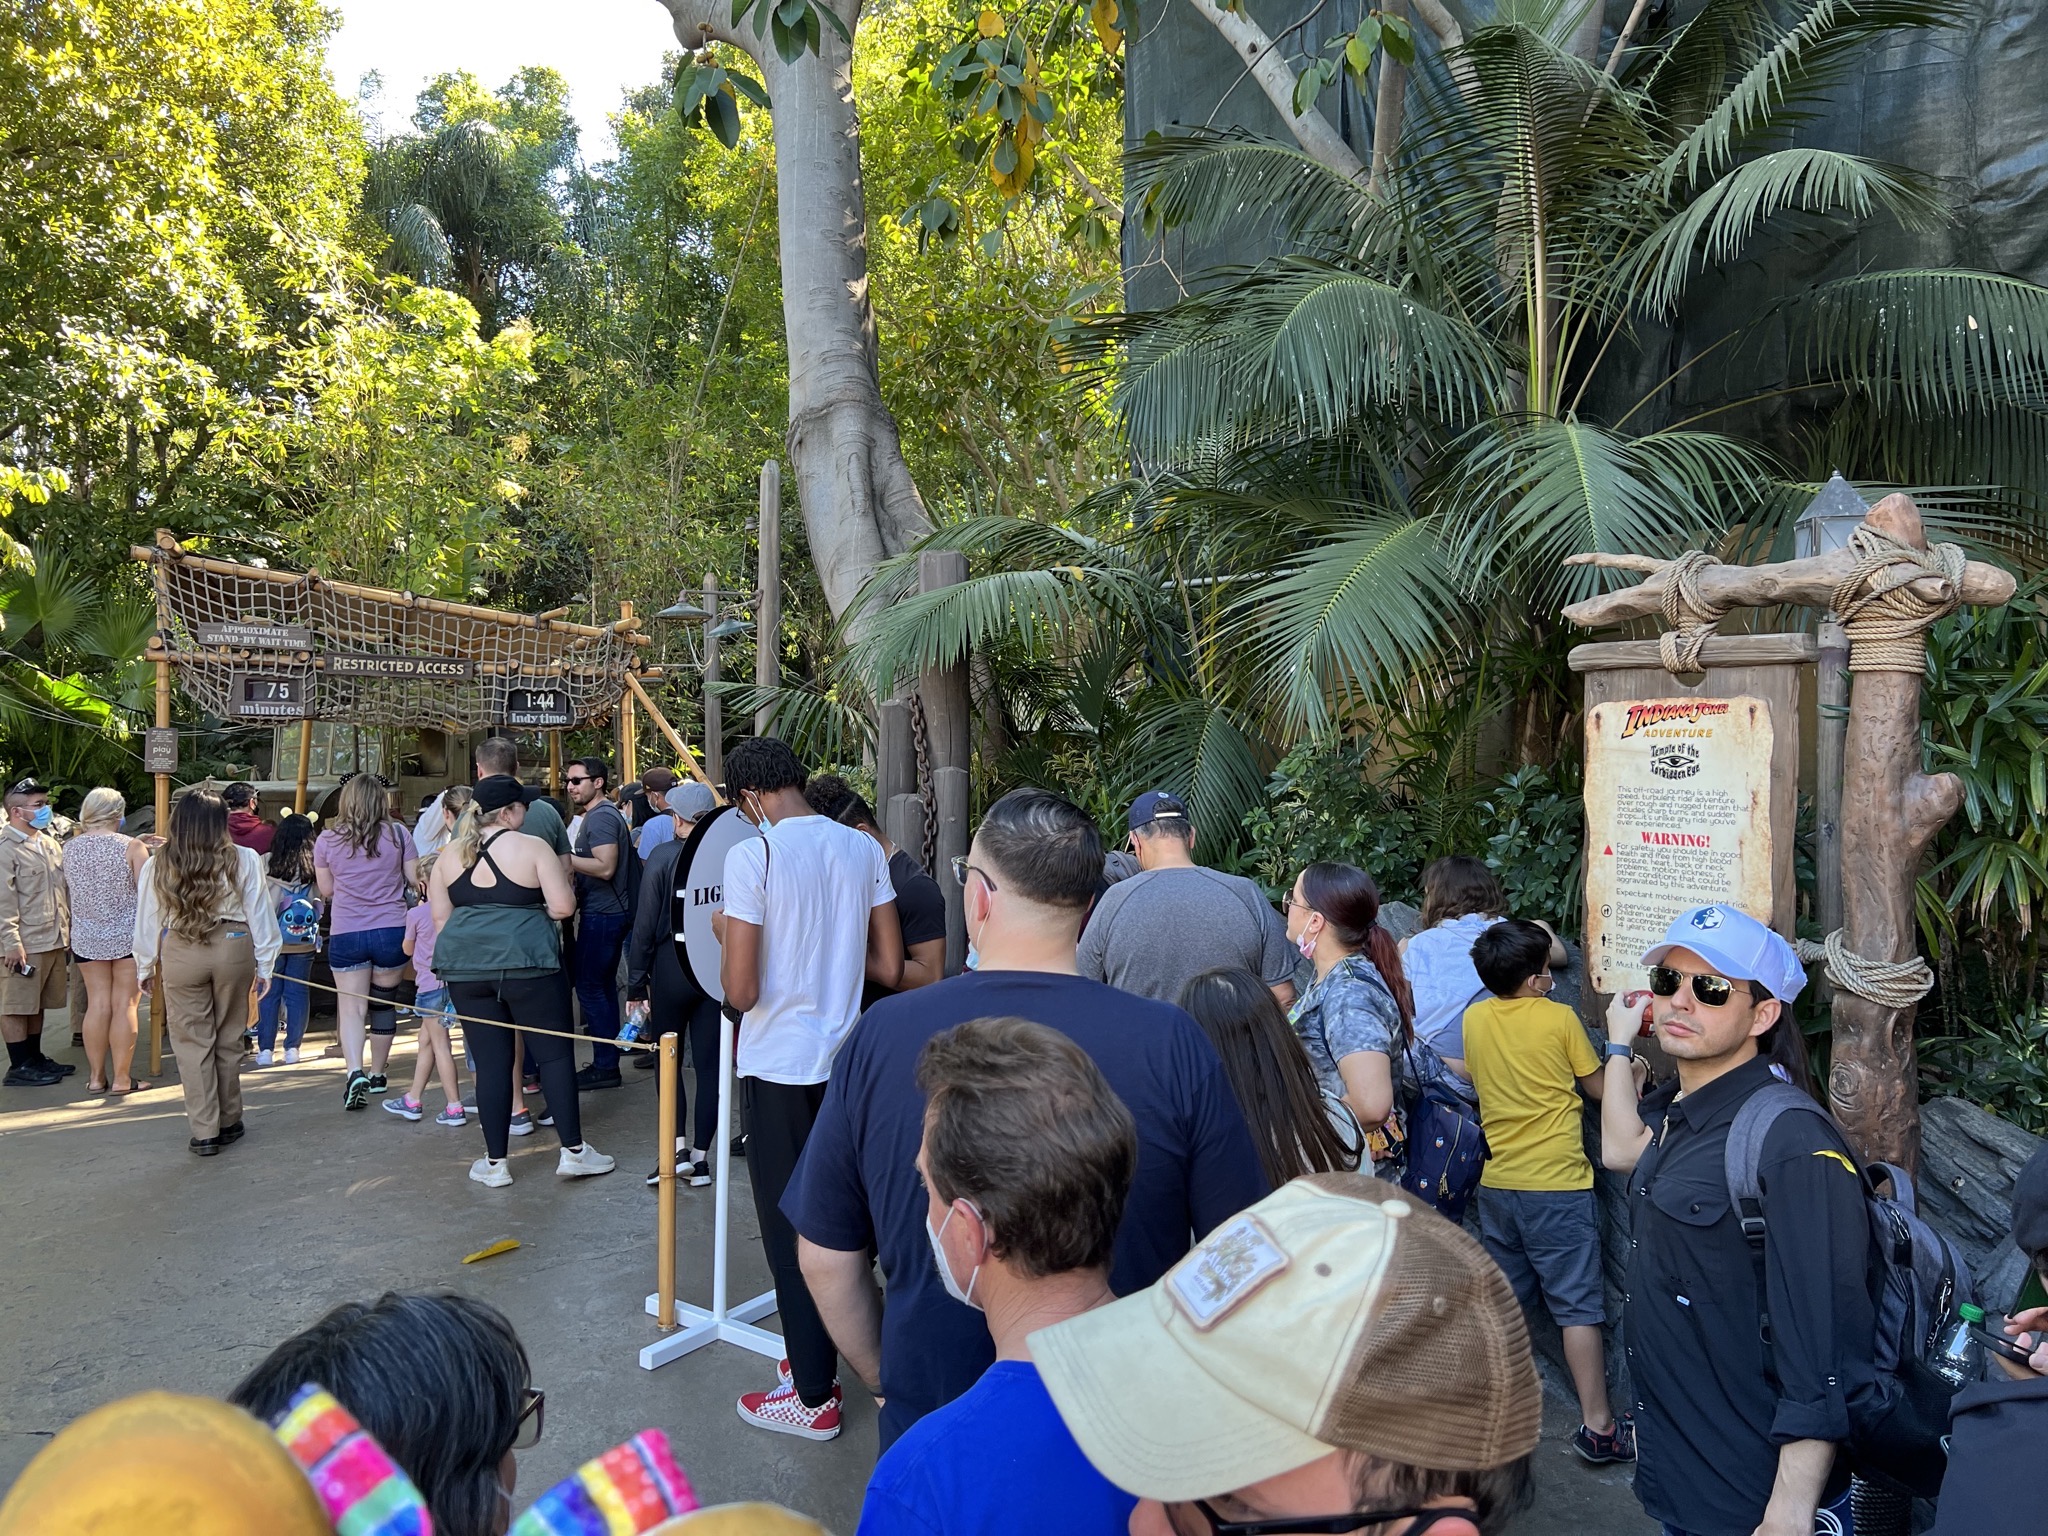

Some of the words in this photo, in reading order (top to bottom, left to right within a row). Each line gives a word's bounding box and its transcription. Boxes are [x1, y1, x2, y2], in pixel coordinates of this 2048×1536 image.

[221, 625, 289, 636] APPROXIMATE
[207, 634, 256, 644] STAND-BY
[259, 637, 281, 647] WAIT
[282, 639, 307, 647] TIME
[333, 657, 412, 672] RESTRICTED
[415, 660, 465, 675] ACCESS
[267, 682, 290, 699] 75
[525, 692, 555, 708] 1:44
[239, 703, 304, 715] minutes
[511, 712, 537, 724] Indy
[539, 714, 567, 724] time
[1620, 703, 1694, 740] INDIANA
[1688, 702, 1729, 724] JONES
[1643, 728, 1714, 738] ADVENTURE
[152, 745, 171, 754] play
[1650, 744, 1675, 758] Temple
[1677, 743, 1686, 754] of
[1687, 745, 1700, 758] the
[1650, 760, 1687, 780] Forbidden
[1686, 764, 1701, 778] Eye
[1642, 794, 1675, 802] turbulent
[1695, 796, 1735, 804] adventure
[1666, 788, 1695, 797] journey
[1712, 789, 1728, 798] high
[1617, 806, 1645, 814] includes
[1647, 807, 1667, 816] sharp
[1691, 809, 1705, 817] and
[1707, 811, 1736, 819] sudden
[1635, 800, 1657, 809] rough
[1675, 802, 1701, 811] rugged
[1703, 803, 1730, 811] terrain
[1733, 804, 1750, 812] that
[1654, 814, 1675, 822] unlike
[1677, 817, 1691, 825] any
[1693, 816, 1707, 824] ride
[1641, 831, 1711, 848] WARNING!
[1617, 849, 1638, 857] health
[1655, 852, 1670, 860] free
[1672, 853, 1690, 861] from
[1692, 855, 1708, 864] high
[1709, 856, 1732, 865] blood
[1657, 847, 1671, 855] you
[1673, 847, 1697, 855] should
[1720, 851, 1741, 860] good
[1652, 866, 1679, 874] motion
[1717, 871, 1726, 879] or
[1675, 861, 1692, 869] back
[1705, 863, 1725, 871] neck
[1616, 876, 1658, 886] aggravated
[1660, 879, 1669, 889] by
[1671, 880, 1685, 888] this
[1686, 882, 1729, 892] adventure.
[1638, 871, 1677, 881] conditions
[1679, 874, 1695, 882] that
[1698, 876, 1719, 885] could
[1721, 878, 1731, 886] be
[1616, 888, 1653, 899] Expectant
[1655, 892, 1687, 903] mothers
[1689, 895, 1714, 905] should
[1616, 901, 1651, 911] Supervise
[1653, 905, 1682, 915] children
[1616, 908, 1644, 917] Children
[1646, 911, 1667, 920] under
[1625, 923, 1645, 931] years
[1616, 933, 1645, 943] Persons
[1616, 941, 1647, 951] minimum
[1616, 960, 1634, 969] Must
